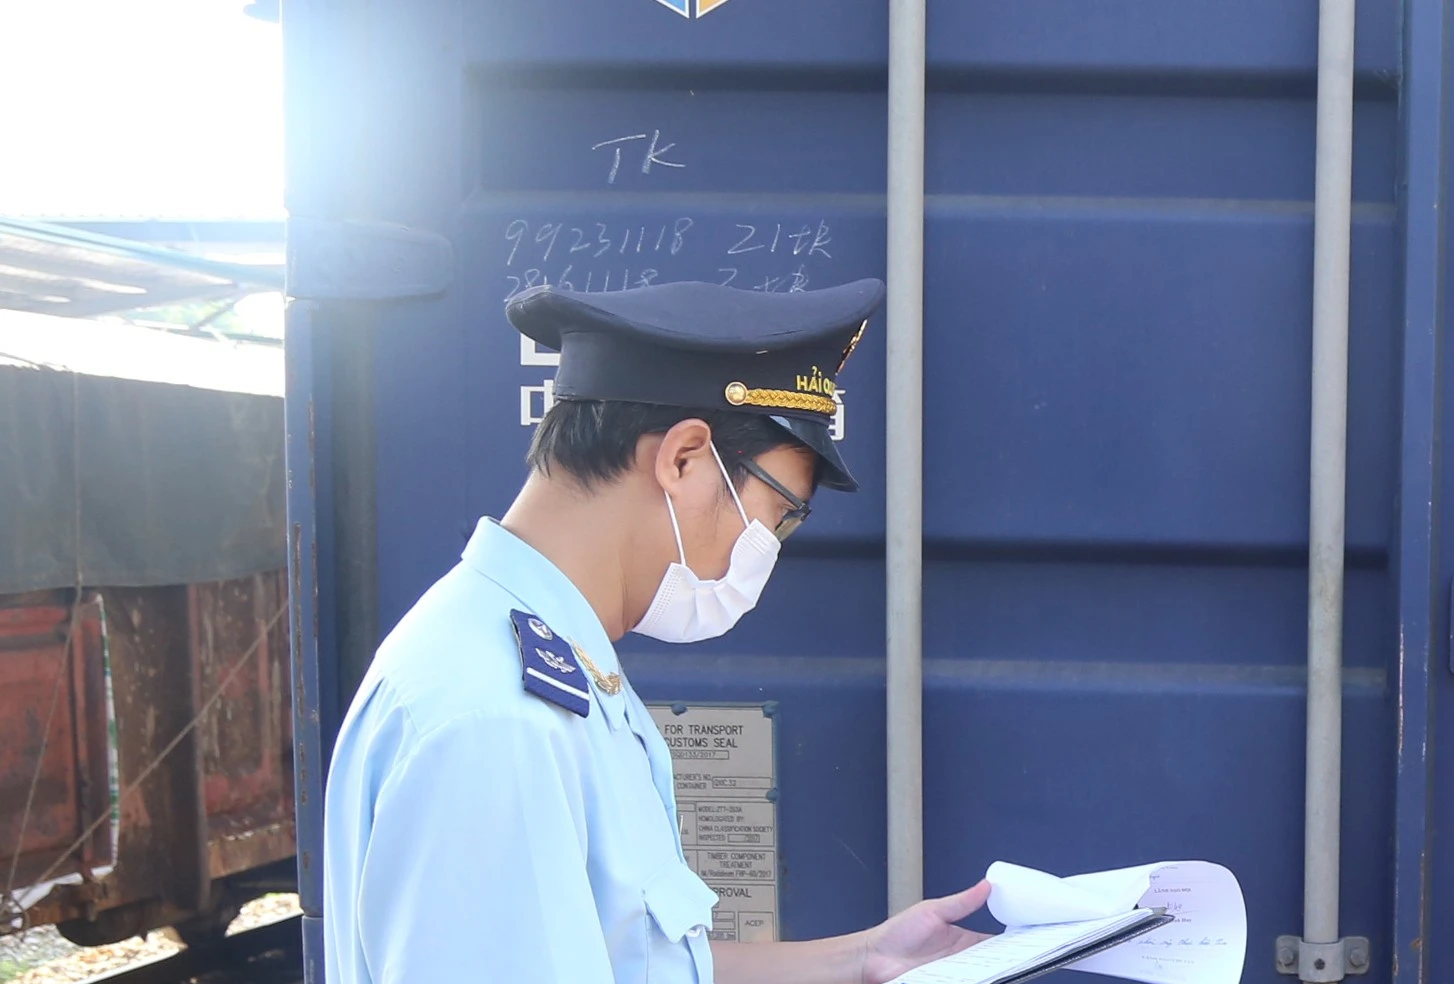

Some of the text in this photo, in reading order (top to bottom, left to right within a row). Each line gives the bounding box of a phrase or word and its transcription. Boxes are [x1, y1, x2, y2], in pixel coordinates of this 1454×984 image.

[664, 724, 744, 735] FOR TRANSPORT
[713, 737, 738, 748] SEAL
